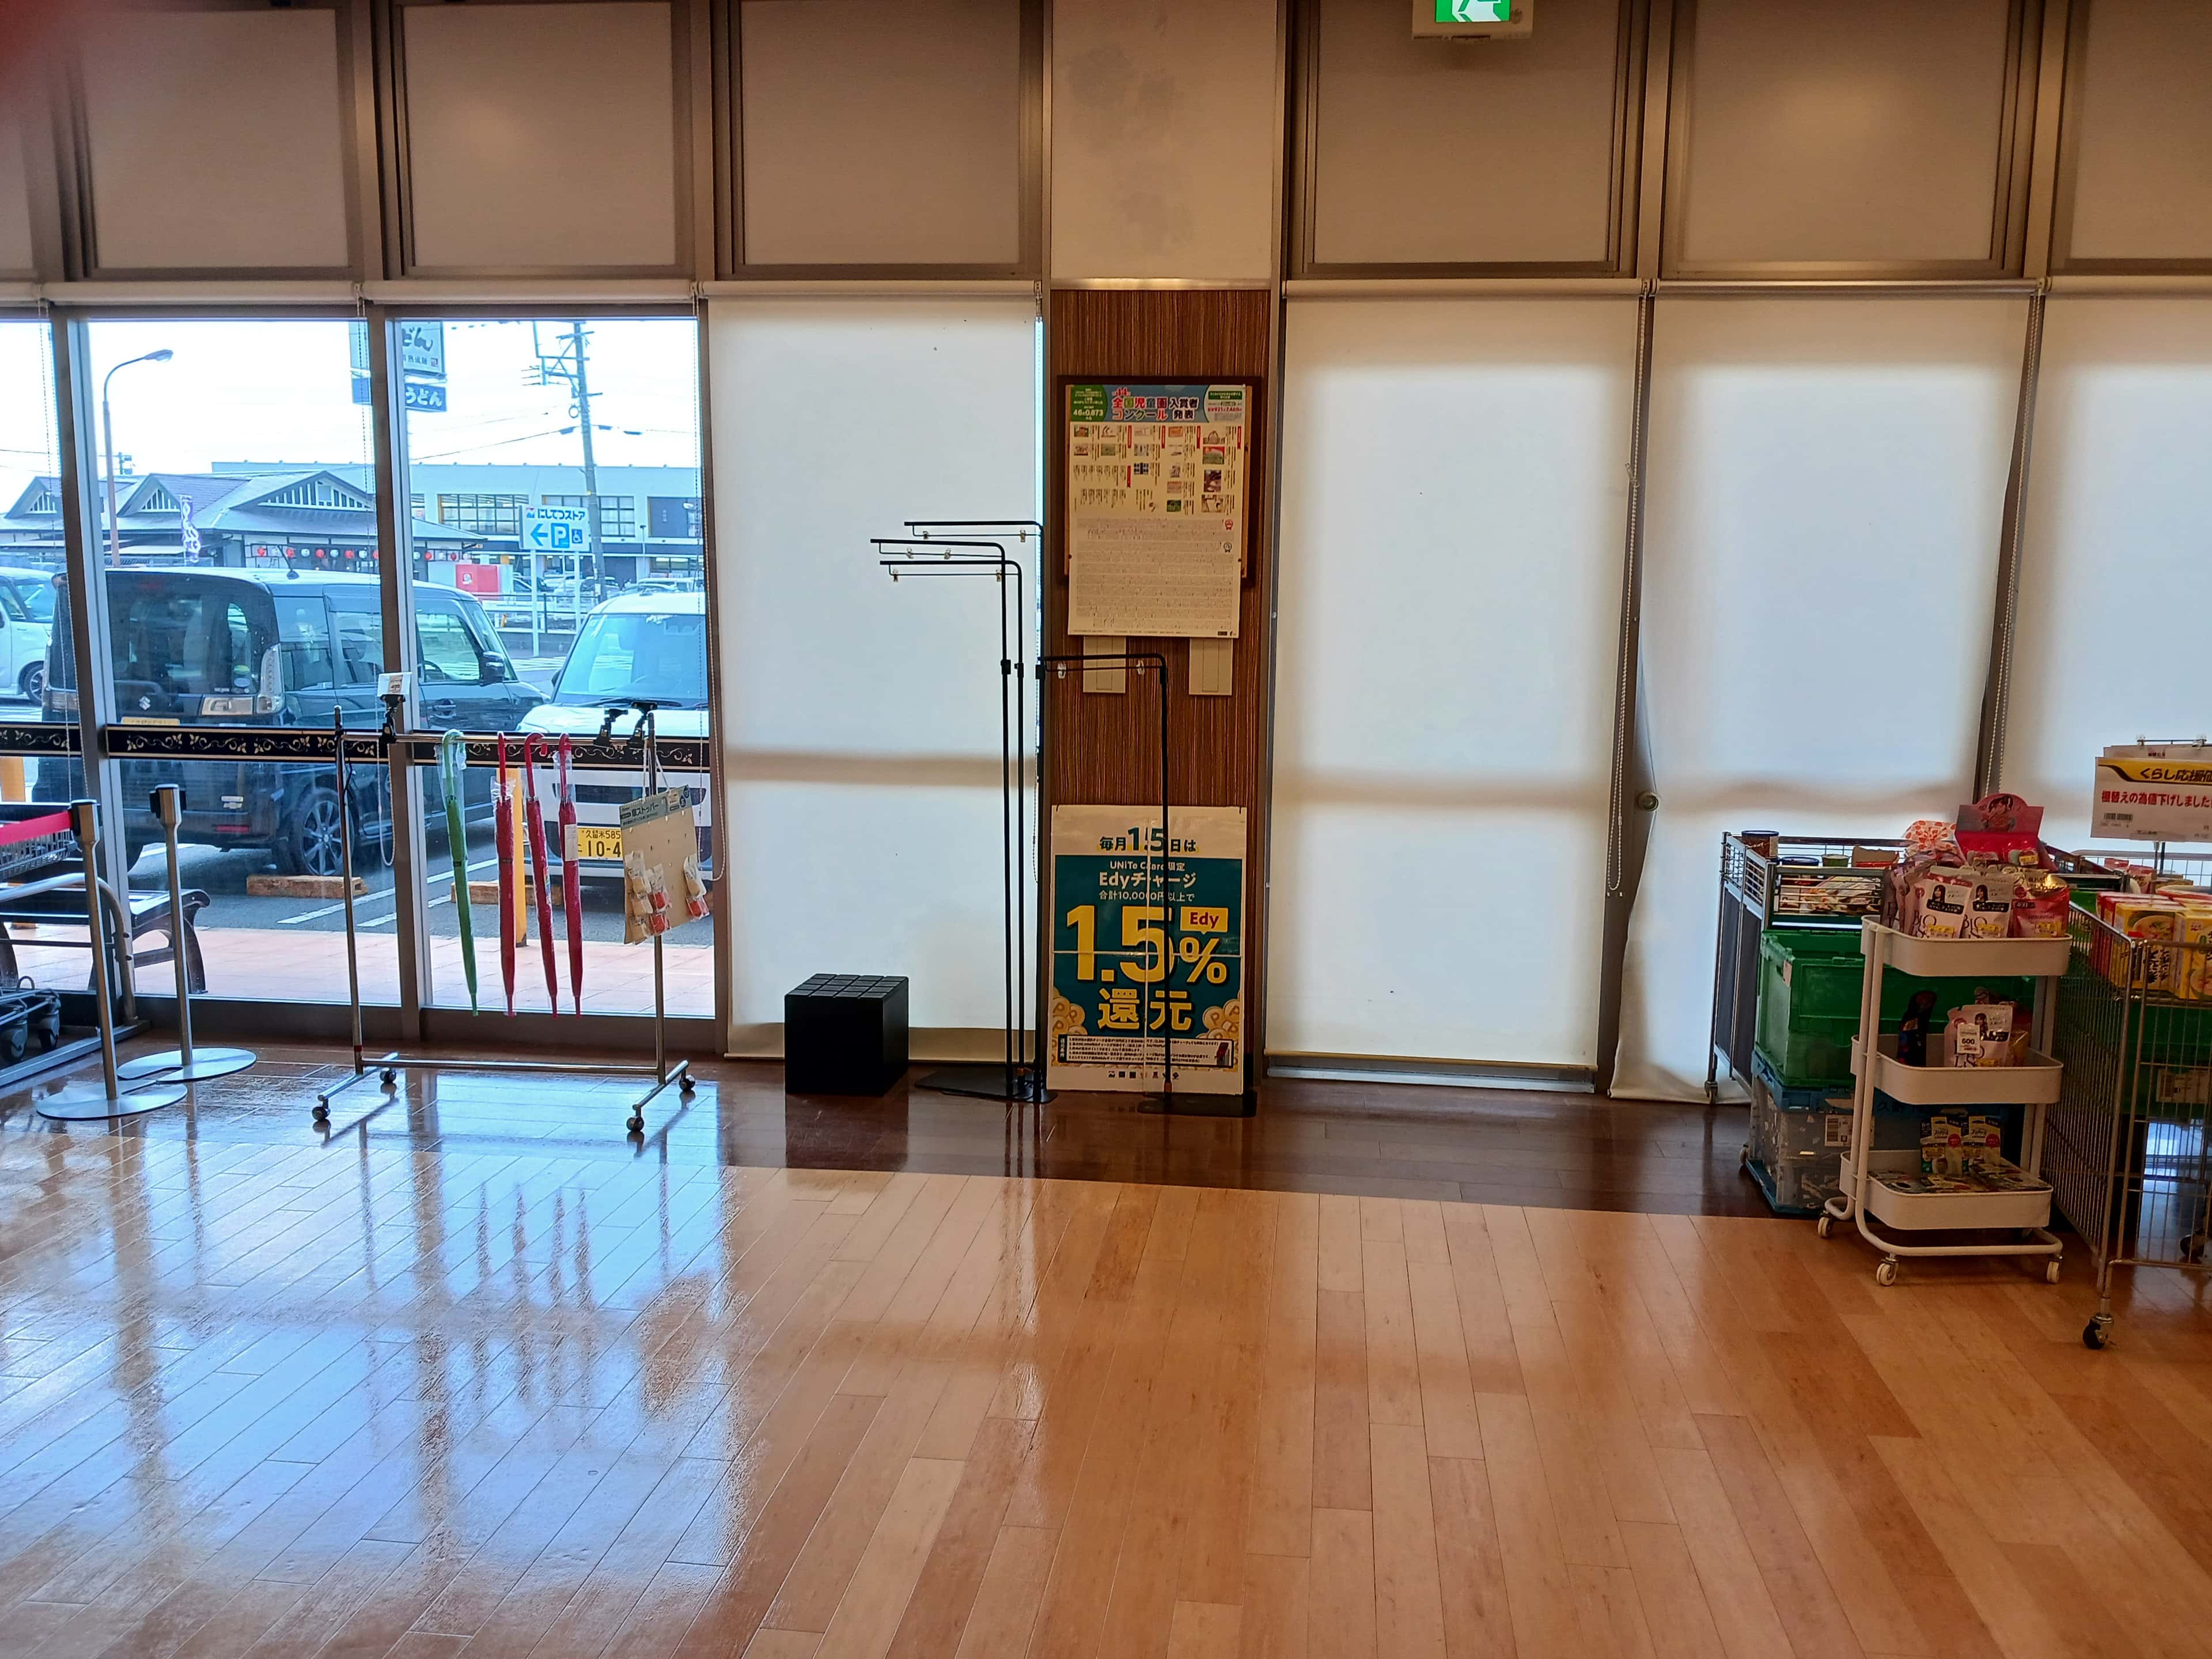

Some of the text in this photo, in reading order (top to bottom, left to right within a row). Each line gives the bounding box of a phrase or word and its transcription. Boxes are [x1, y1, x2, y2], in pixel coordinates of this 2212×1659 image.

[406, 387, 442, 407] うどん
[1112, 397, 1167, 408] 全国児童画
[1169, 397, 1199, 408] 入賞者
[1112, 409, 1167, 421] コンクール
[1172, 409, 1195, 421] 発表
[537, 509, 586, 521] にしてつストア
[554, 526, 566, 546] P
[1099, 827, 1196, 852] 毎月15日は
[1190, 911, 1219, 928] Edy
[1097, 987, 1192, 1031] 還元
